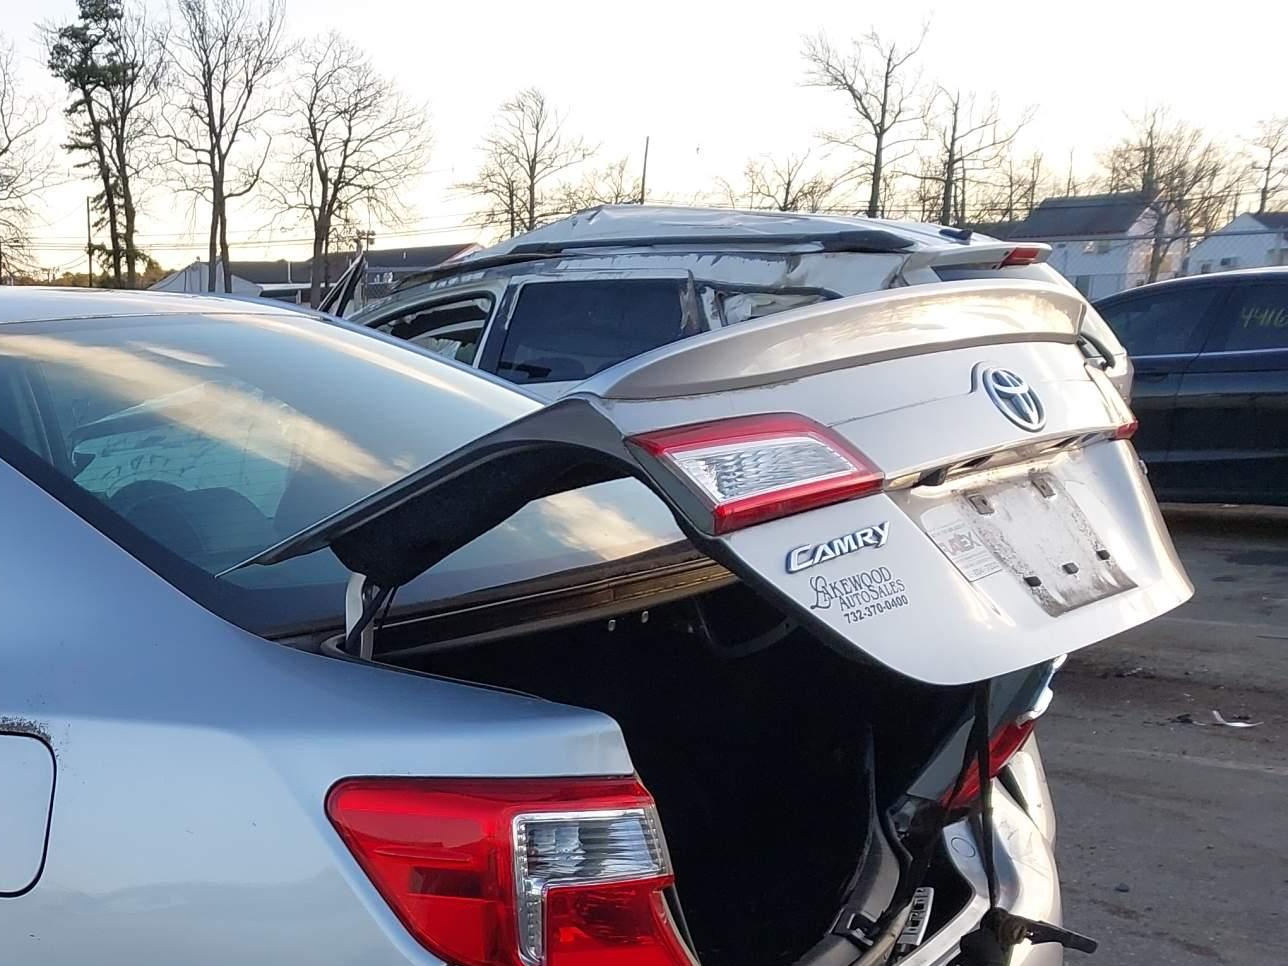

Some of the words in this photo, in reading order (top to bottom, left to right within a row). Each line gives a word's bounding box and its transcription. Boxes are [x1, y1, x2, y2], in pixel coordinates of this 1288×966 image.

[785, 521, 890, 574] CAMRY
[810, 566, 892, 610] LAKEWOOD
[843, 595, 908, 624] 732-370-0400
